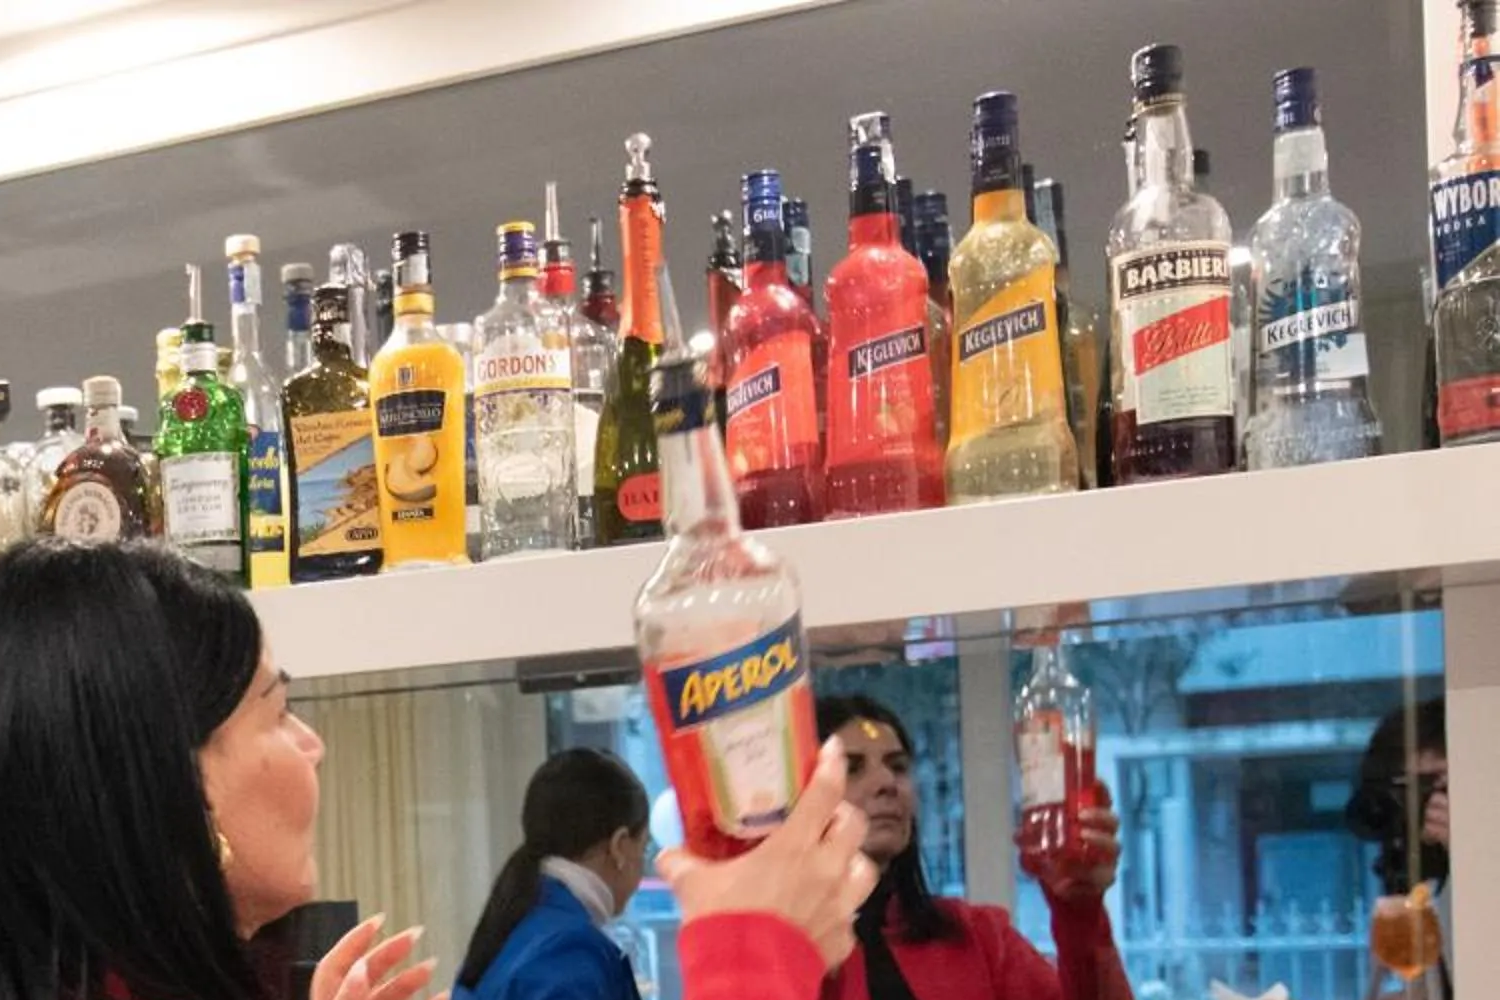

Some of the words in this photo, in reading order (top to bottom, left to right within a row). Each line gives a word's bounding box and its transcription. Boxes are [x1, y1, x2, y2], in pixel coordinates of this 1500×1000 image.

[965, 307, 1040, 351] KEGLEVICH
[1266, 307, 1351, 345] KEGLEVICH
[856, 335, 922, 370] KEGLEVICH
[678, 637, 798, 720] APEROL
